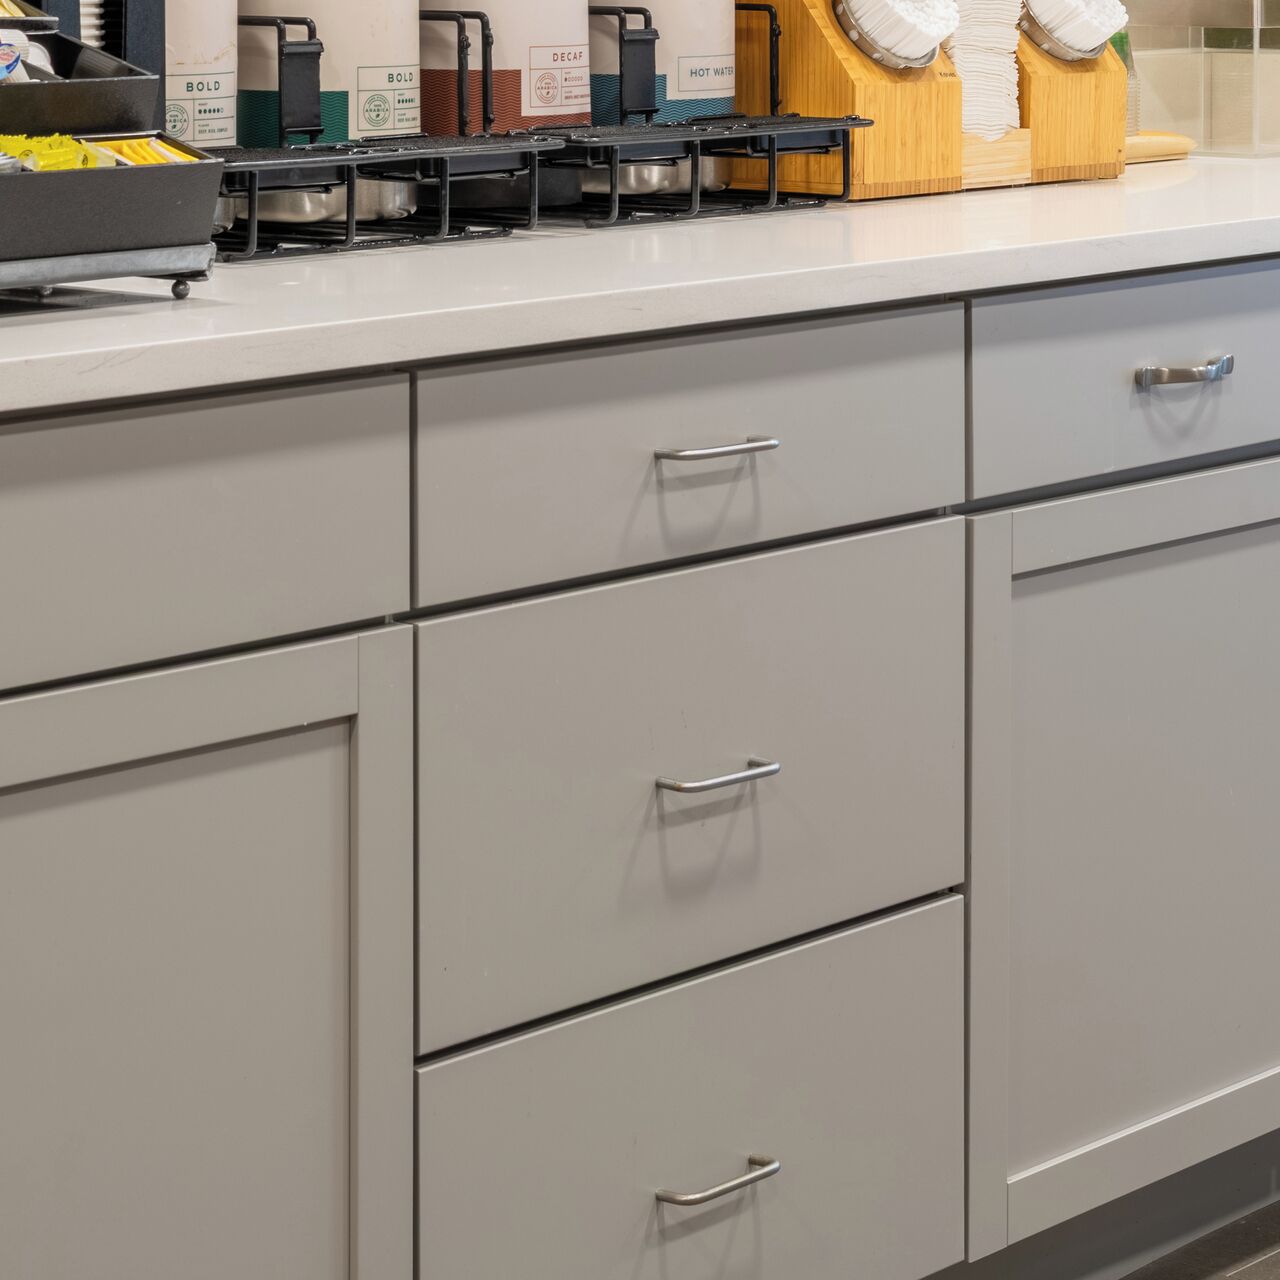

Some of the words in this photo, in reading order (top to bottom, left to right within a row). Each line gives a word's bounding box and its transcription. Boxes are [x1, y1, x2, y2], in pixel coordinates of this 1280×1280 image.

[552, 51, 583, 62] DECAF
[690, 67, 710, 77] HOT
[713, 65, 734, 77] WATER
[387, 72, 414, 83] BOLD
[186, 80, 220, 92] BOLD
